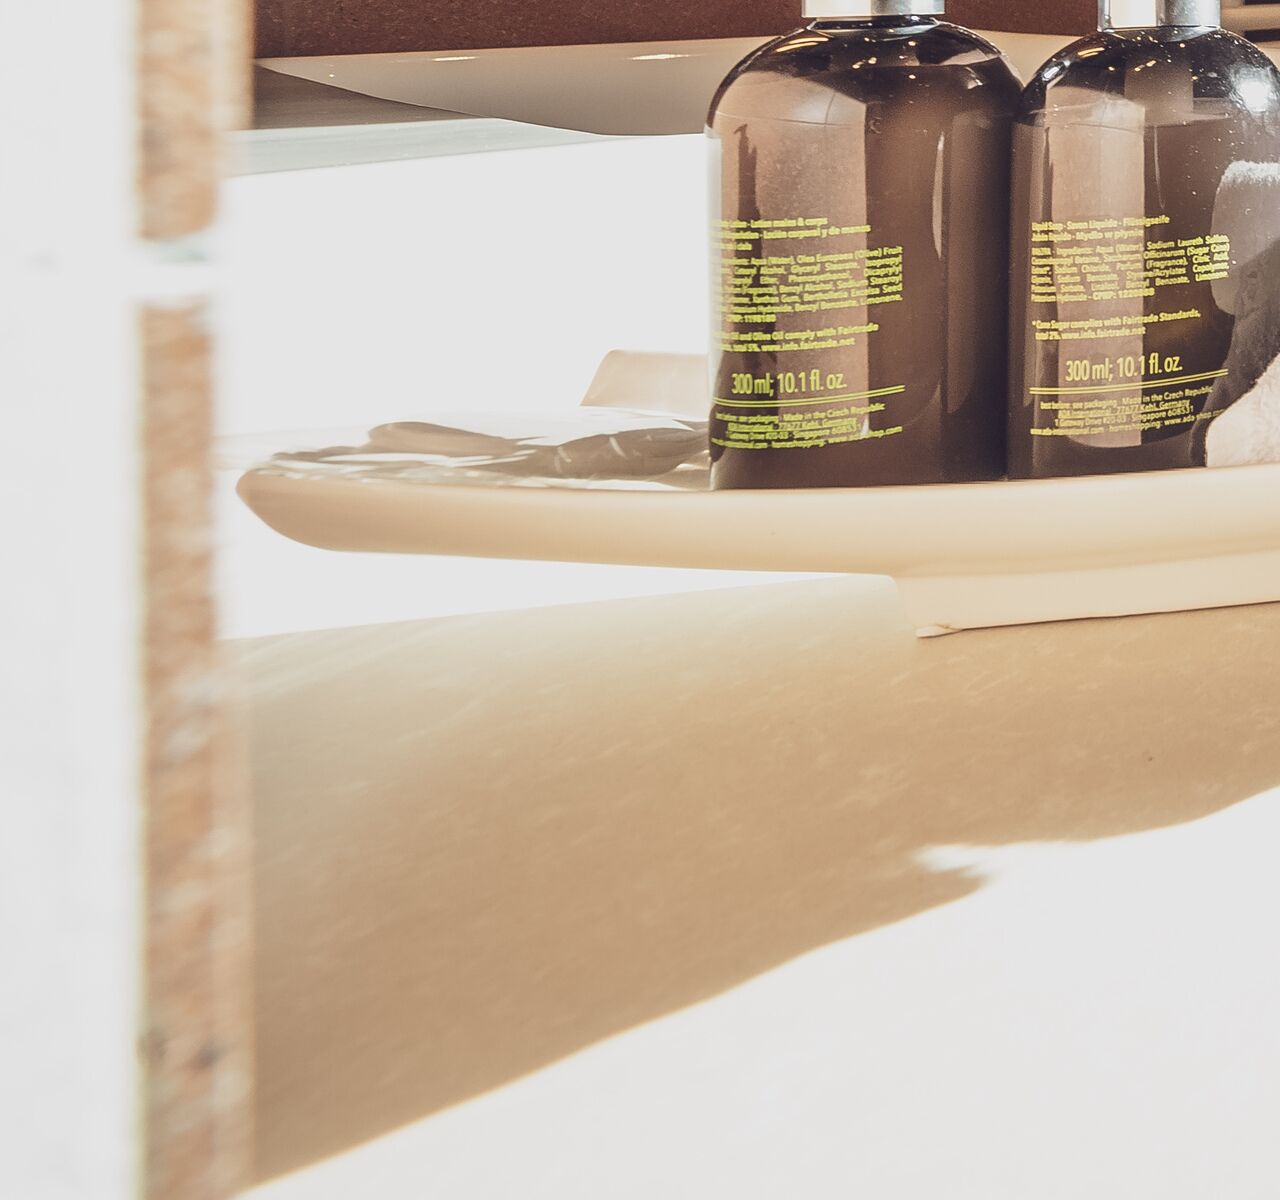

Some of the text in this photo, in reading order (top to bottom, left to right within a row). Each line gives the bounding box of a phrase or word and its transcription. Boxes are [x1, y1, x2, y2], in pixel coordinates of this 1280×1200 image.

[1104, 231, 1114, 239] w
[1146, 240, 1175, 250] Sodium
[1177, 236, 1204, 247] Laureth
[883, 245, 903, 256] Fruit
[1186, 246, 1210, 257] (Sugar
[882, 282, 903, 294] Seed
[1070, 318, 1103, 330] complies
[1103, 317, 1122, 327] with
[1122, 313, 1159, 325] Fairtrade
[1159, 308, 1201, 322] Standards,
[1065, 352, 1184, 383] 300 ml; 10.1 fl. oz.
[731, 368, 849, 398] 300 ml; 10.1 fl. oz.
[1151, 393, 1163, 402] the
[1163, 390, 1184, 400] Czech
[1184, 384, 1213, 397] Republic
